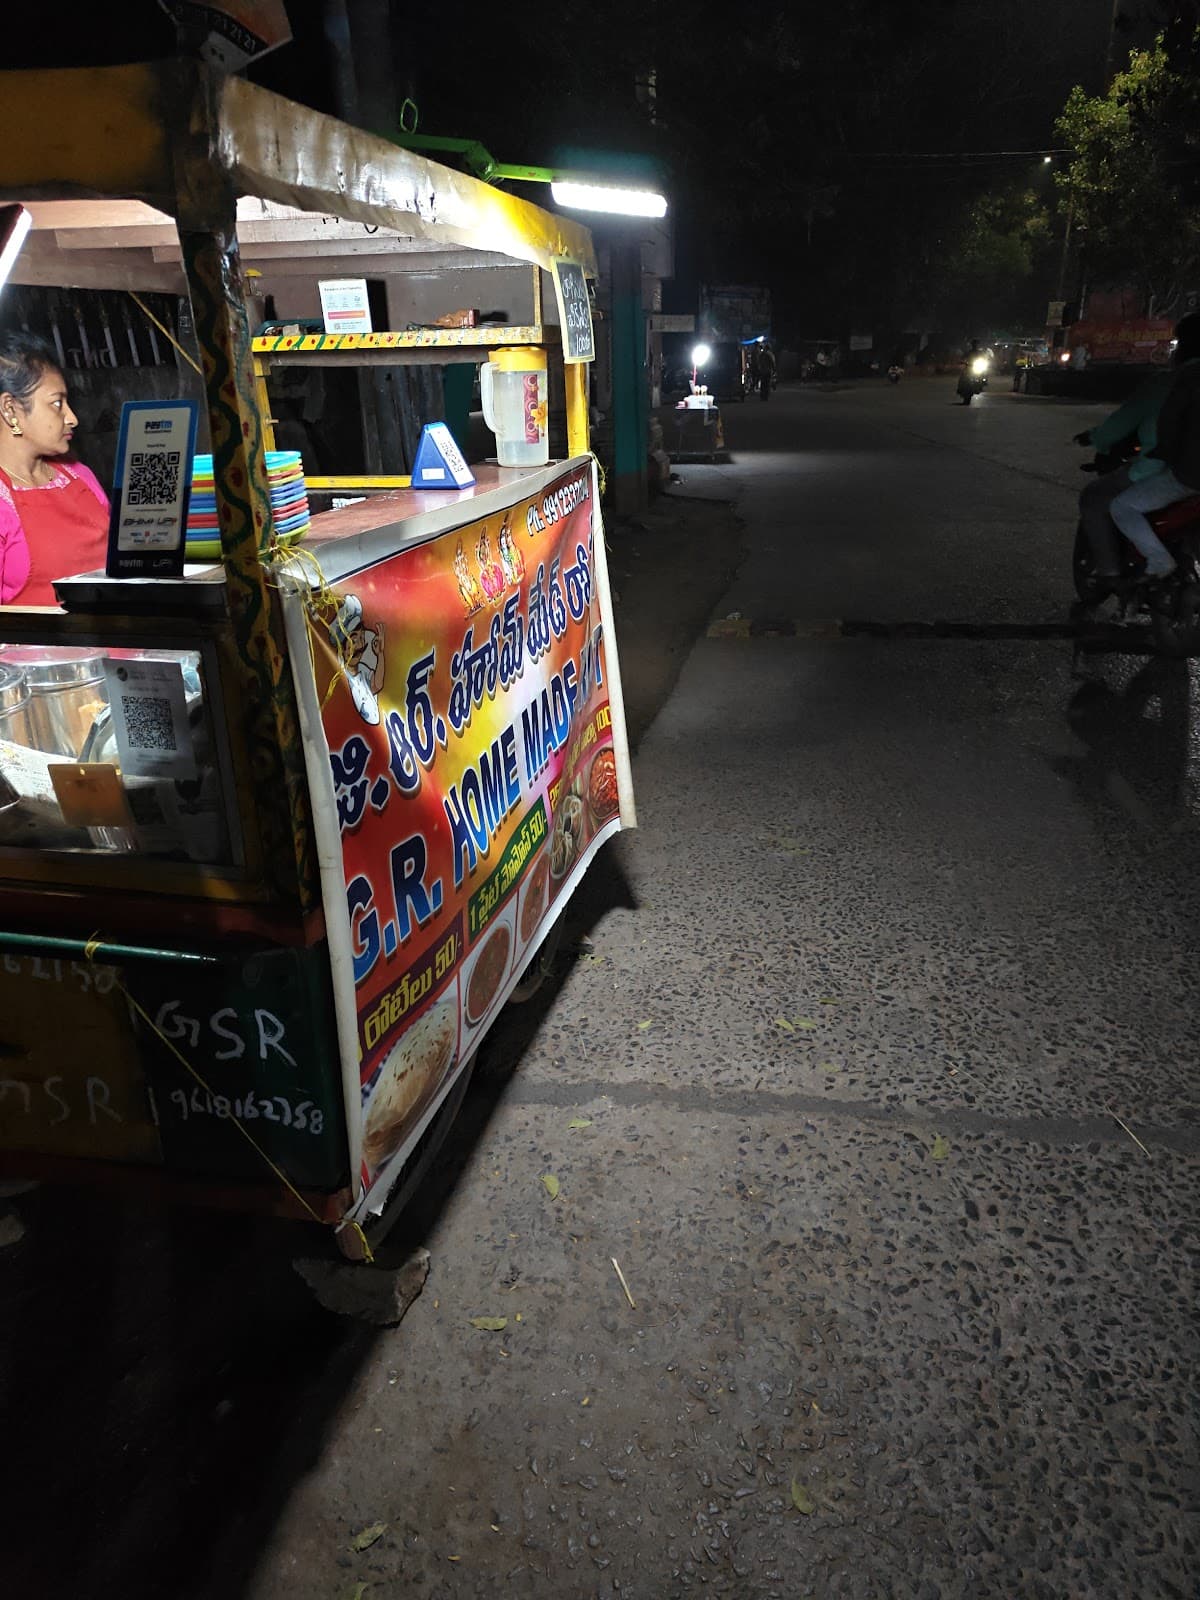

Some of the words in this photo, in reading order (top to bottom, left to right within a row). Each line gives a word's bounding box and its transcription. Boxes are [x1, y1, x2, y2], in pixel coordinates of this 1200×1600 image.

[443, 723, 523, 886] HOME
[521, 658, 577, 782] MADE
[470, 904, 477, 932] 1
[529, 809, 547, 844] 50/-
[435, 933, 462, 980] 50/-
